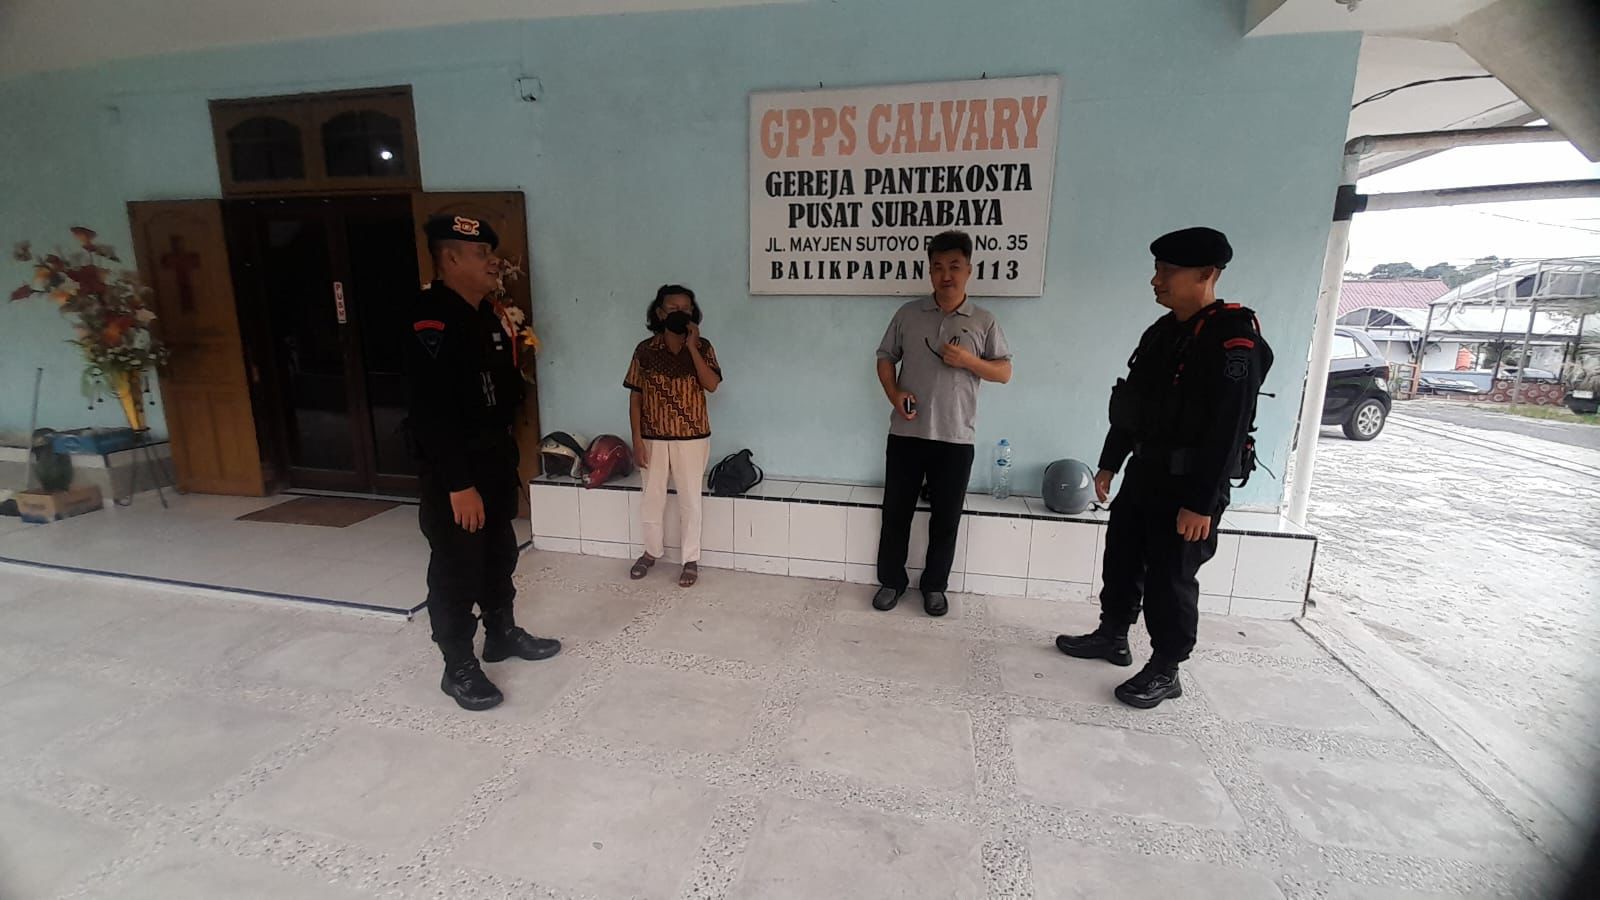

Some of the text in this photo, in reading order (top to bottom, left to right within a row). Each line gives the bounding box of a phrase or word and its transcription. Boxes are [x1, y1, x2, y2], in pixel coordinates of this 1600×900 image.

[761, 95, 1048, 159] GPPS CALVARY
[765, 163, 1032, 199] GEREJA PANTEKOSTA
[788, 199, 1003, 228] PUSAT SURABAYA
[765, 237, 786, 252] JL.
[790, 236, 852, 252] MAYJEN
[856, 235, 919, 252] SUTOYO
[975, 235, 1002, 250] No.
[1006, 234, 1028, 251] 35
[771, 260, 1019, 280] BALIKPAPAN 113
[335, 283, 345, 316] PUSH
